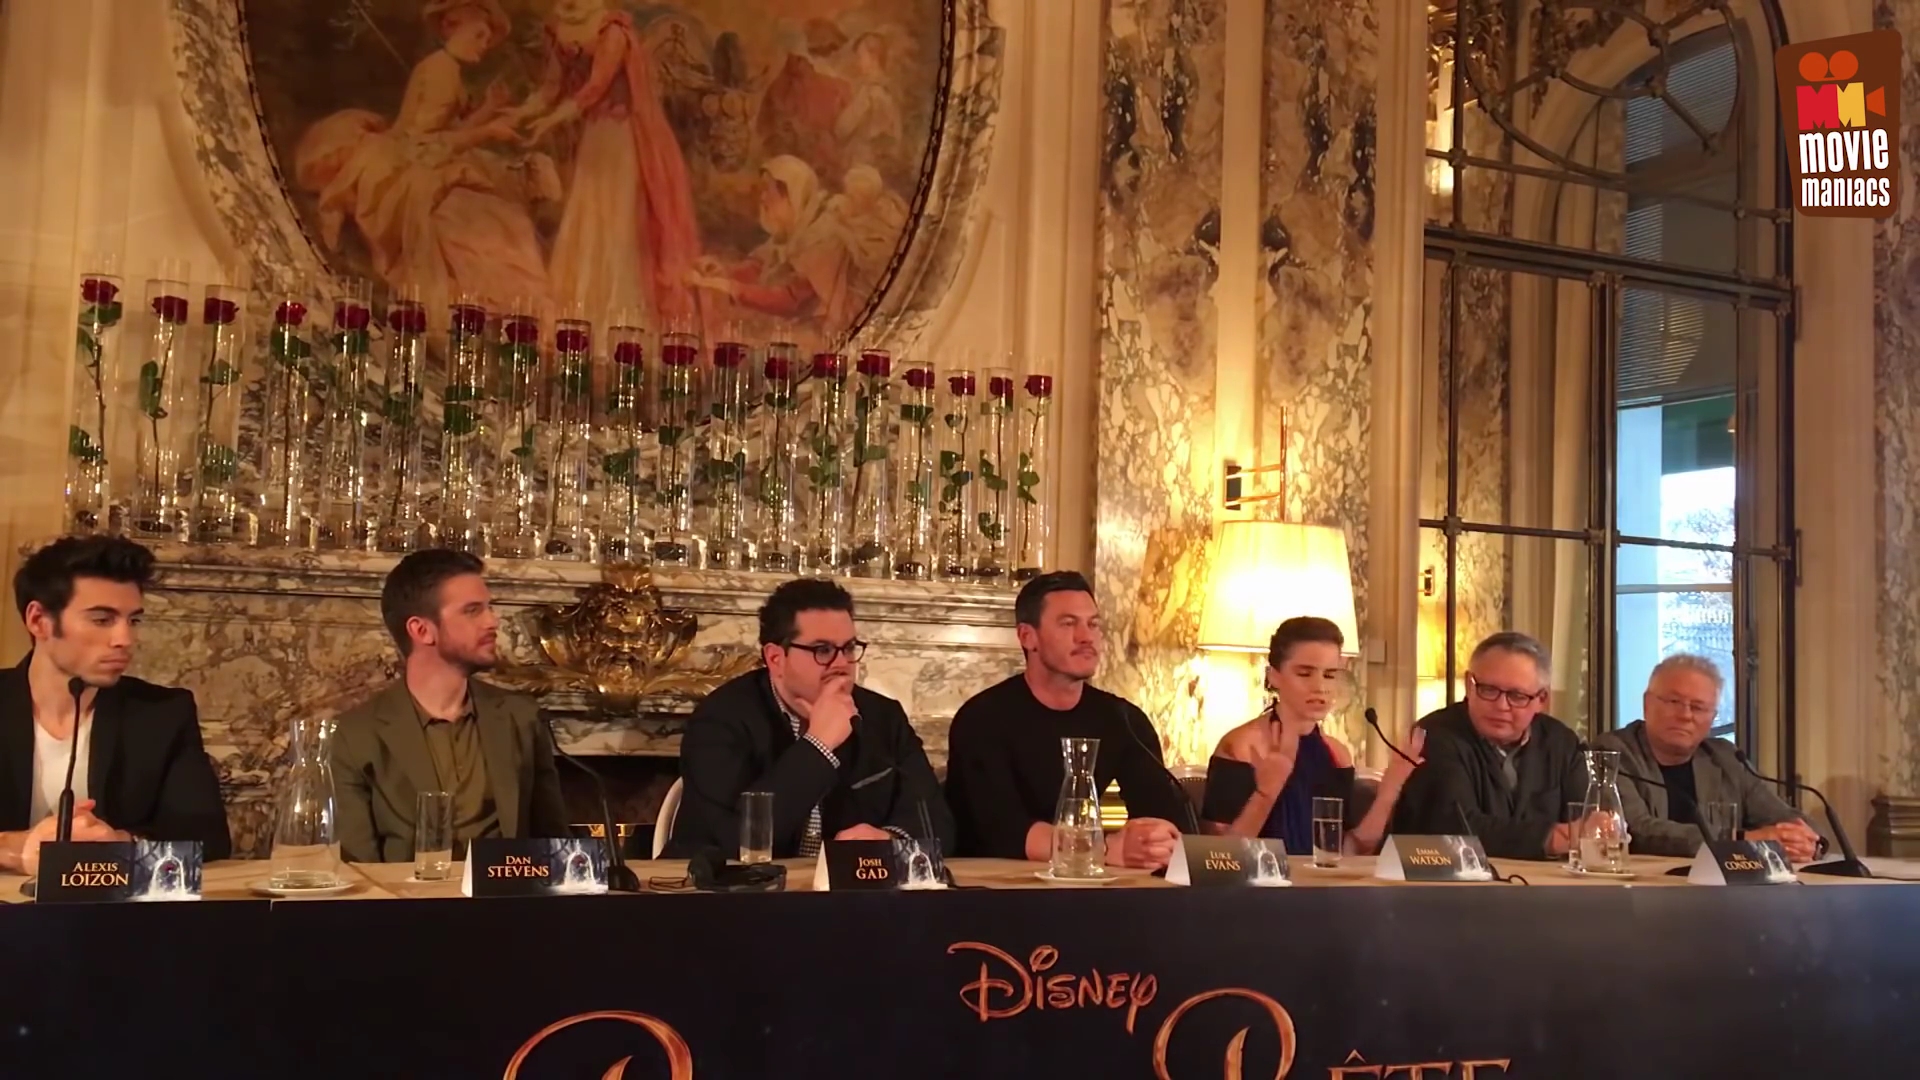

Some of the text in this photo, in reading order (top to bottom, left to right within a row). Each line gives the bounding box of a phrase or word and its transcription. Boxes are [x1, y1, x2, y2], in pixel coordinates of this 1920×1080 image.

[505, 855, 532, 865] DAN
[858, 857, 882, 867] JOSH
[1205, 860, 1241, 871] EVANS
[1409, 855, 1452, 866] WATSON
[1724, 860, 1764, 871] CONDON
[73, 861, 119, 872] ALEXIS
[487, 865, 549, 878] STEVENS
[856, 868, 889, 880] GAD
[61, 873, 129, 887] LOIZON
